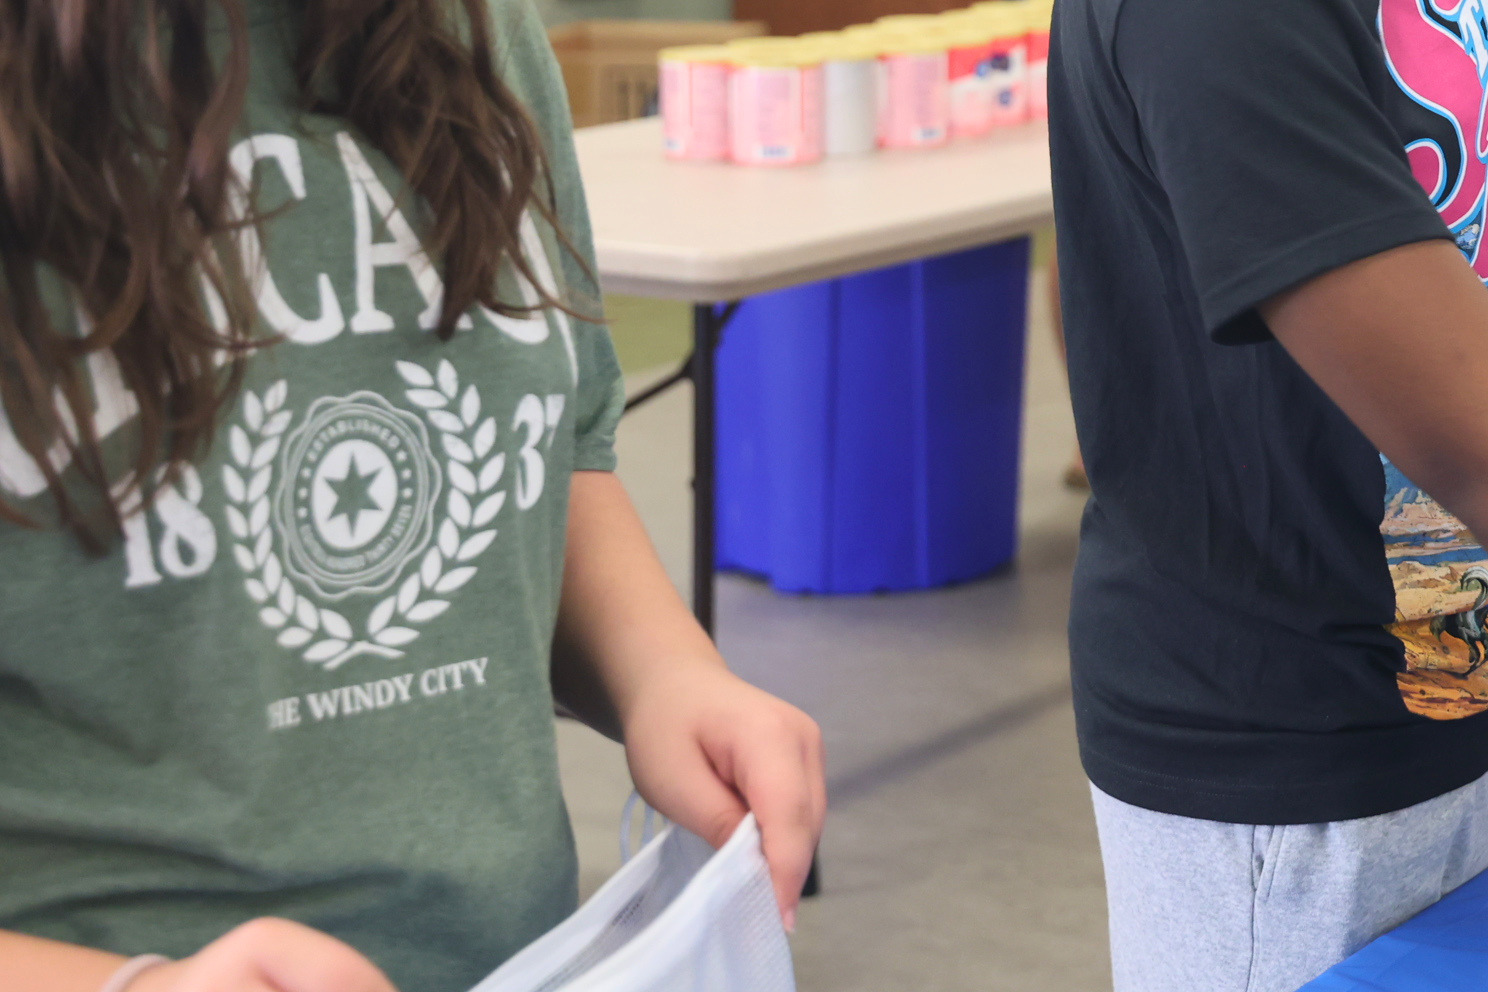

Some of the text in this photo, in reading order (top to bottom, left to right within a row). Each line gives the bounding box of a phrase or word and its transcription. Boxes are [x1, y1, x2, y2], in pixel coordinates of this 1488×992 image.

[109, 460, 218, 589] 18
[267, 657, 489, 730] HE WINDY CITY
